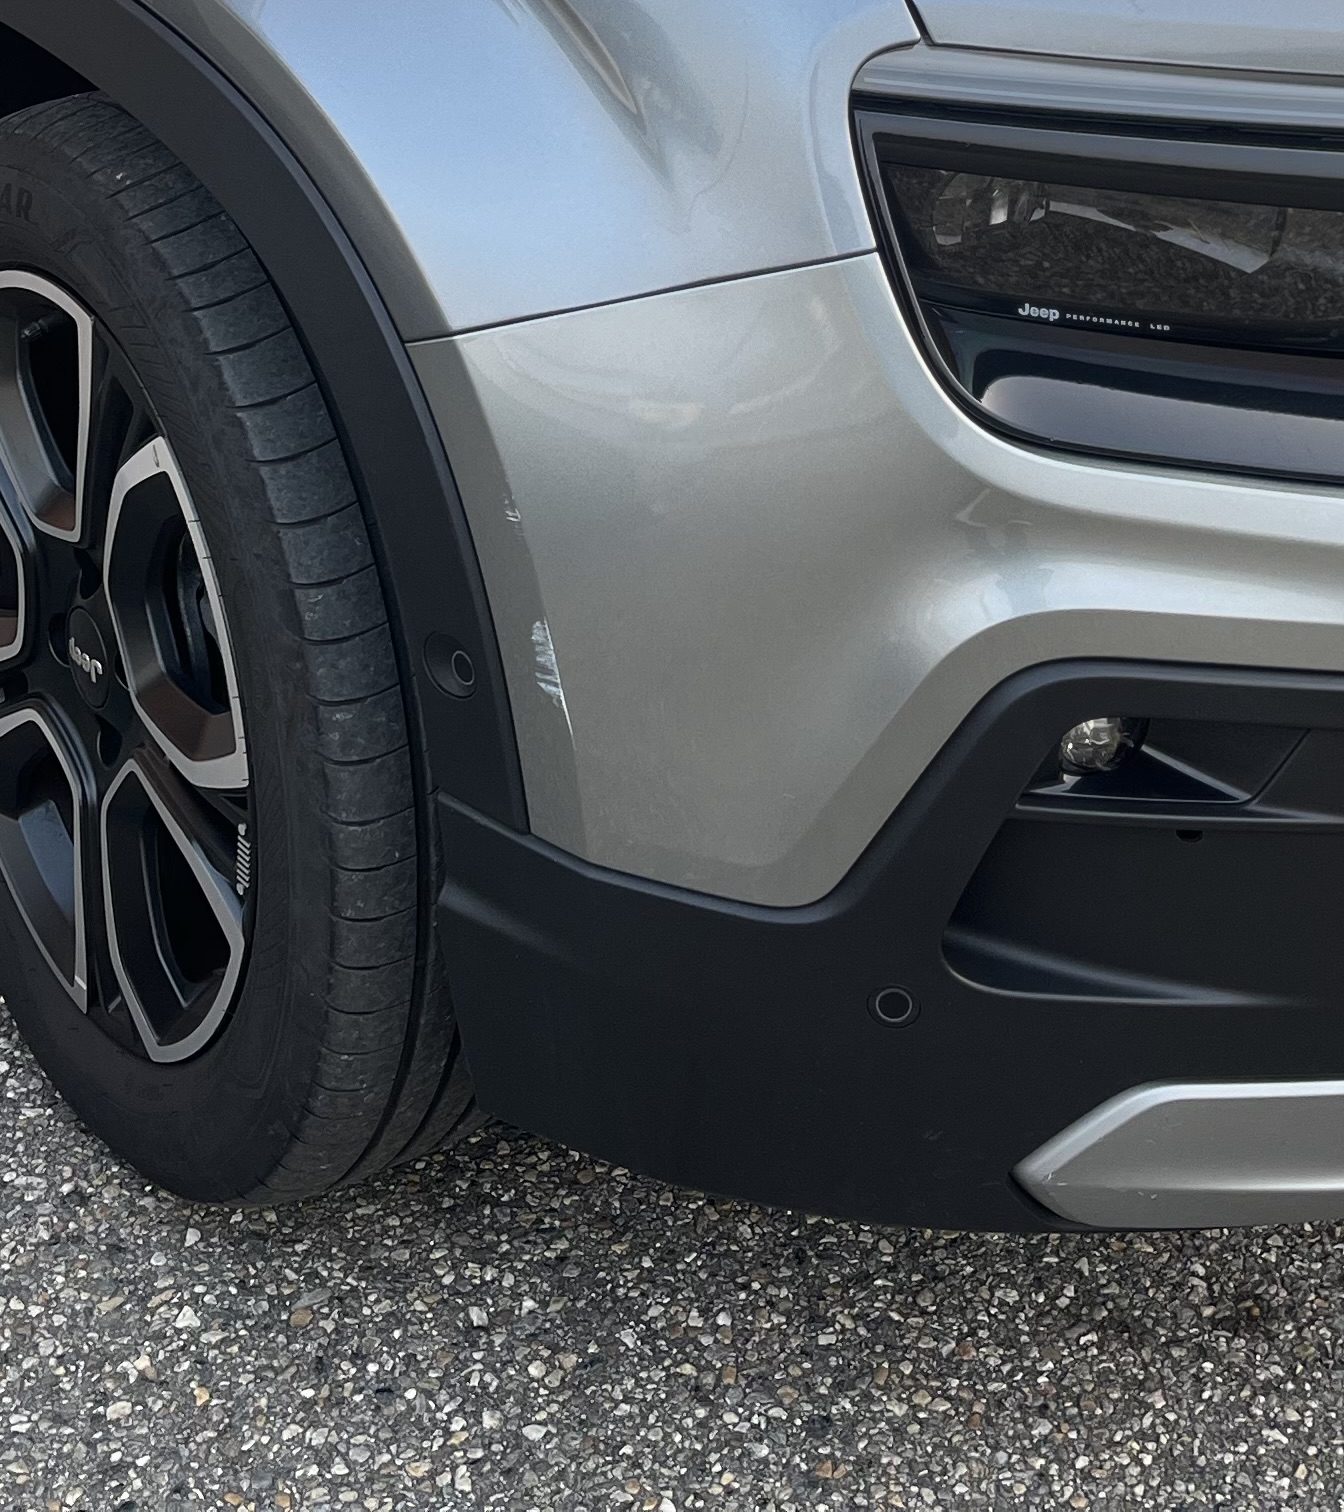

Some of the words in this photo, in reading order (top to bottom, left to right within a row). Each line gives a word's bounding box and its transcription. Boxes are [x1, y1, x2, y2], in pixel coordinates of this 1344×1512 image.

[1017, 302, 1060, 322] Jeep
[1065, 312, 1141, 328] PERFORMANCE
[1149, 322, 1171, 331] LED
